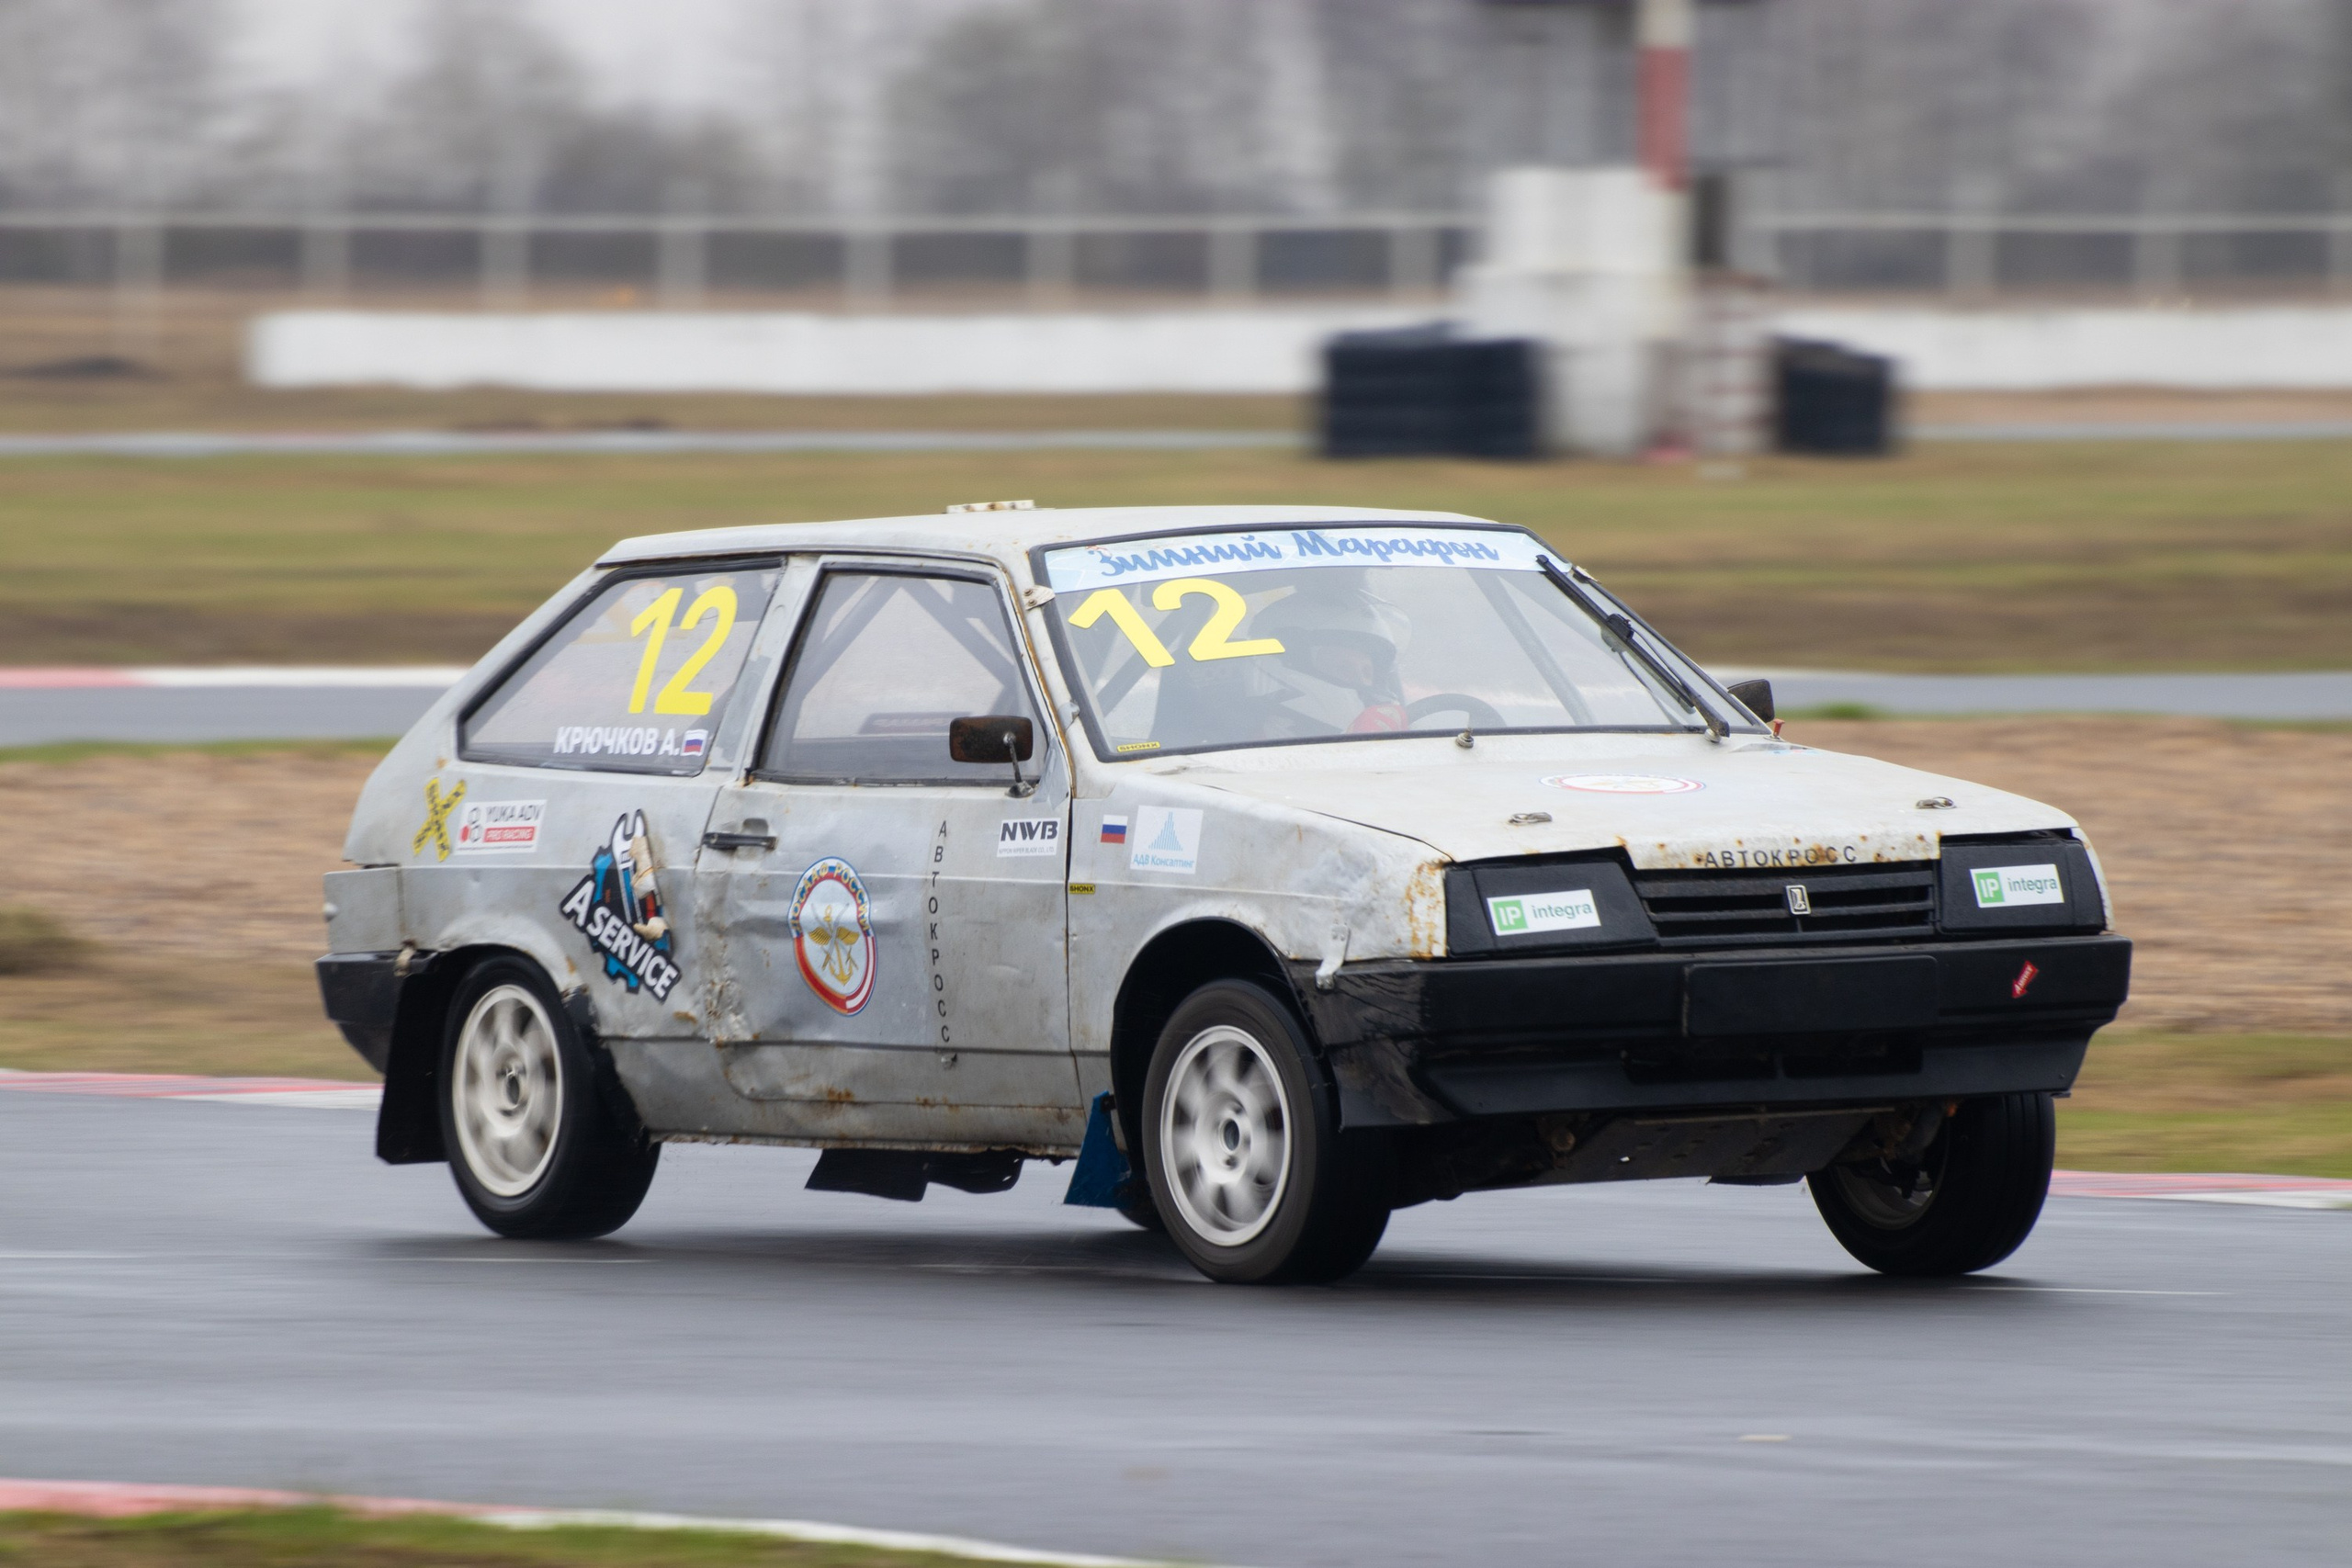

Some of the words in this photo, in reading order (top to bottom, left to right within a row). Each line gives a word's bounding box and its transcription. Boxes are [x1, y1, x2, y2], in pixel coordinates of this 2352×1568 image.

[1088, 535, 1283, 576] Зимний
[1291, 530, 1500, 565] Марафон
[1068, 578, 1286, 668] 12
[628, 585, 738, 715] 12
[553, 726, 661, 754] КРЮЧКОВ
[658, 728, 681, 756] А.
[1001, 820, 1058, 841] NWB
[1134, 854, 1150, 866] АДВ
[1151, 855, 1194, 869] Консалтинг
[1704, 845, 1857, 868] АВТОКРОСС
[832, 863, 871, 931] РОССИИ
[1979, 877, 1999, 898] IP
[2007, 877, 2058, 894] integra
[928, 819, 950, 1043] АВТОКРОСС
[1498, 906, 1521, 926] IP
[1531, 903, 1593, 919] integra
[585, 906, 679, 999] SERVICE
